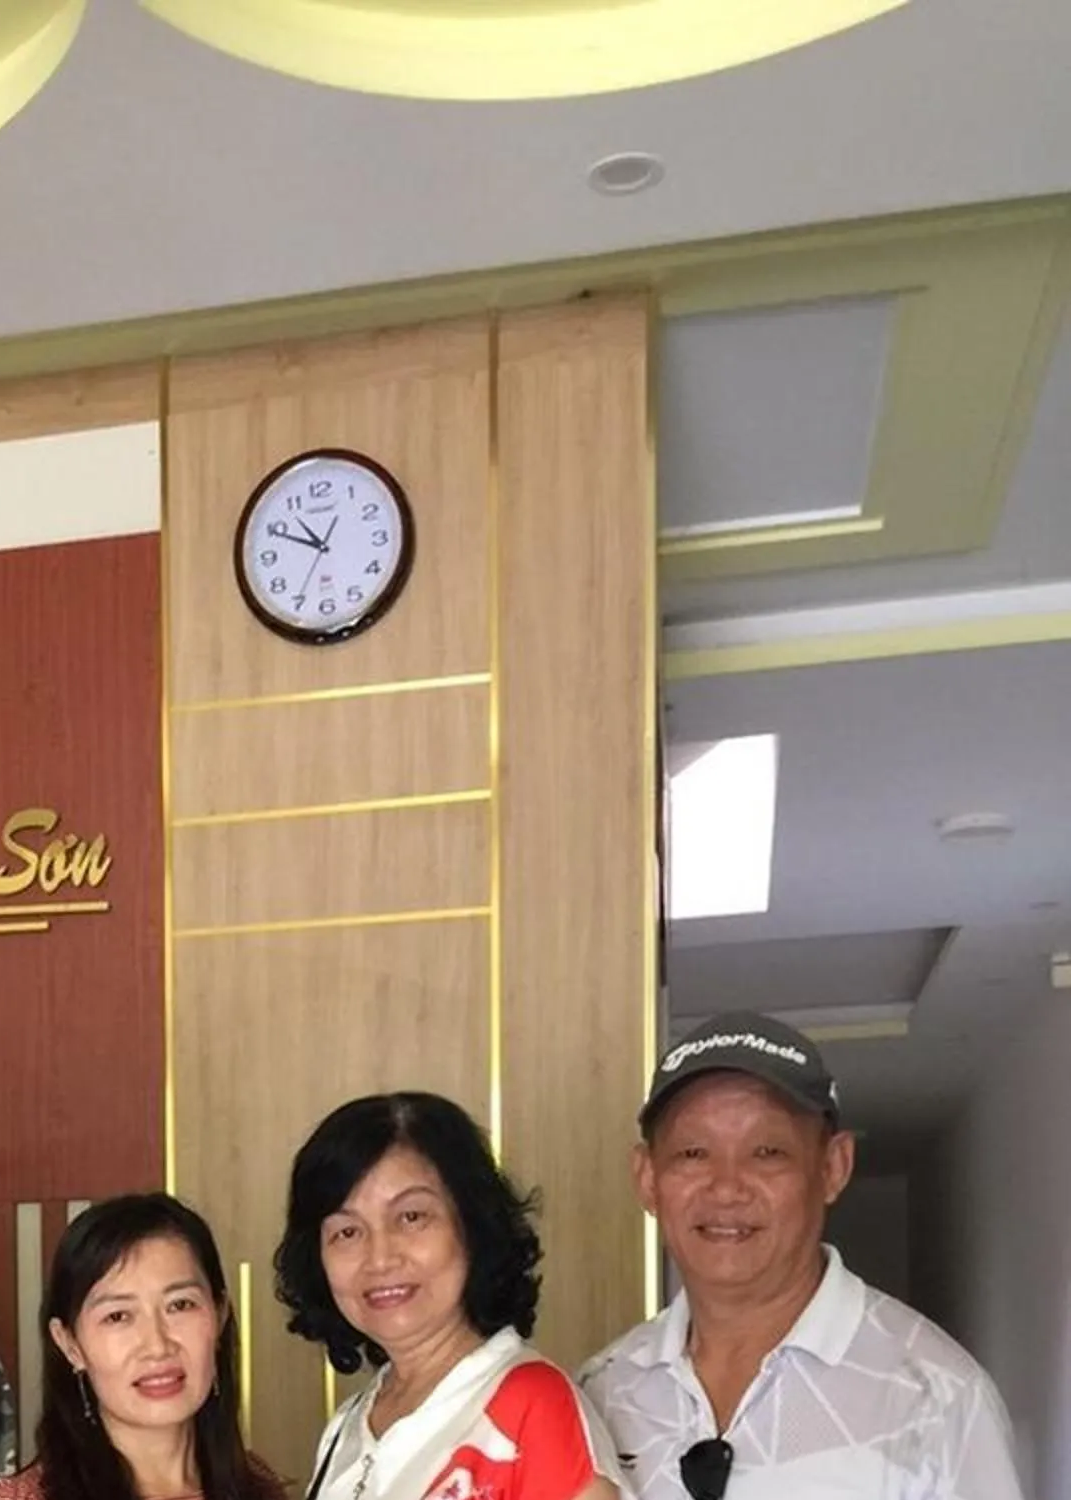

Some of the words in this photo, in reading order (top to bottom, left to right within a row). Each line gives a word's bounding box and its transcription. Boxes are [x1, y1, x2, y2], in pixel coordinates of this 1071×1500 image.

[309, 481, 333, 498] 12
[286, 495, 301, 510] 11
[362, 503, 379, 521] 2
[371, 530, 389, 547] 3
[260, 550, 277, 568] 9
[364, 560, 382, 575] 4
[270, 577, 287, 594] 8
[346, 586, 364, 602] 5
[291, 595, 307, 611] 7
[319, 599, 337, 616] 6
[660, 1032, 808, 1072] TaylorMade
